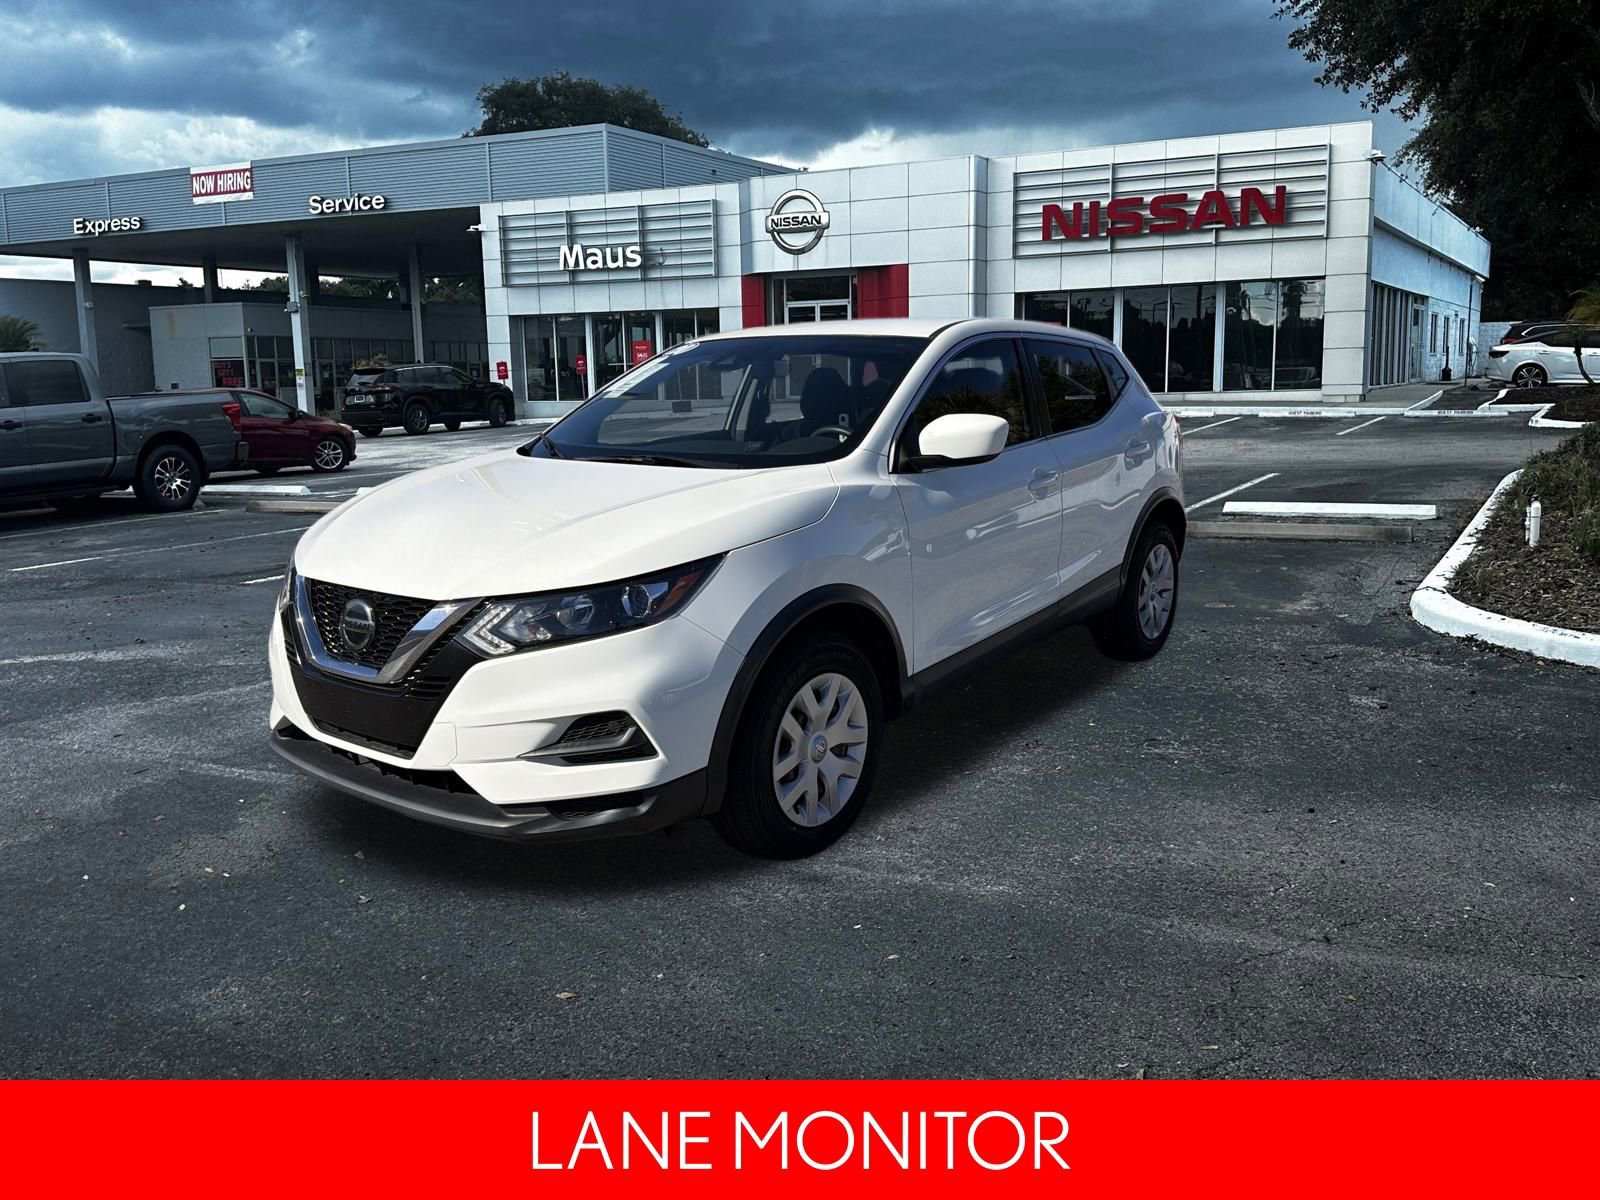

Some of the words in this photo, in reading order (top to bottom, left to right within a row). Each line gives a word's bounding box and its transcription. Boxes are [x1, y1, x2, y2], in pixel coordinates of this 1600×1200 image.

[192, 174, 215, 195] NOW
[217, 170, 251, 193] HIRING
[308, 192, 385, 214] Service
[1042, 185, 1287, 241] NISSAN
[73, 216, 141, 236] Express
[770, 214, 822, 228] NISSAN
[559, 243, 642, 271] Maus
